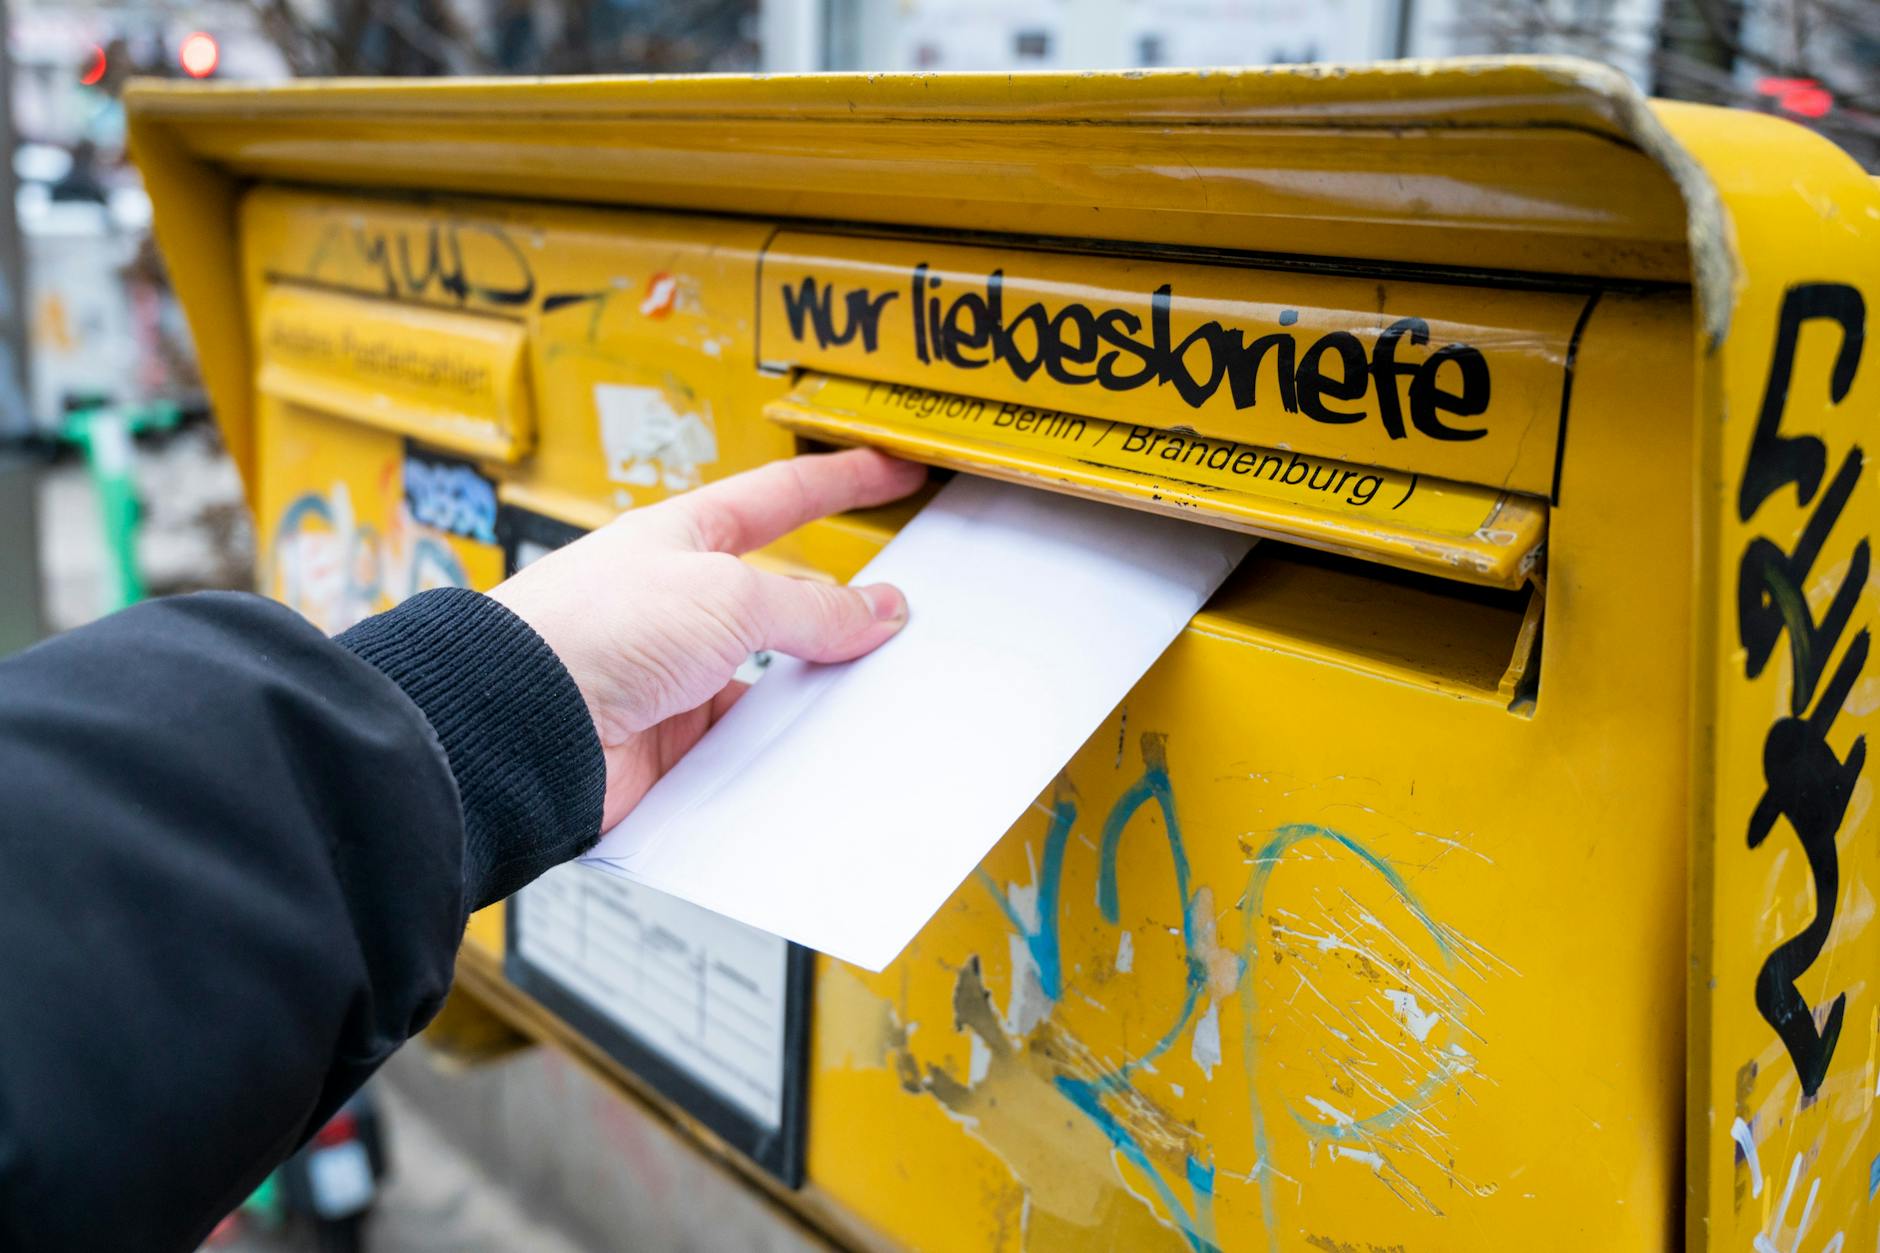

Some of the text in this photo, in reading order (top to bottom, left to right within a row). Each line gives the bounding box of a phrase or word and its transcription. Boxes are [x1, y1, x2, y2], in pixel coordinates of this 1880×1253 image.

[782, 262, 1491, 442] nur liebesbriefe
[884, 384, 986, 421] Region
[993, 402, 1088, 442] Berlin
[1121, 421, 1384, 507] Brandenburg
